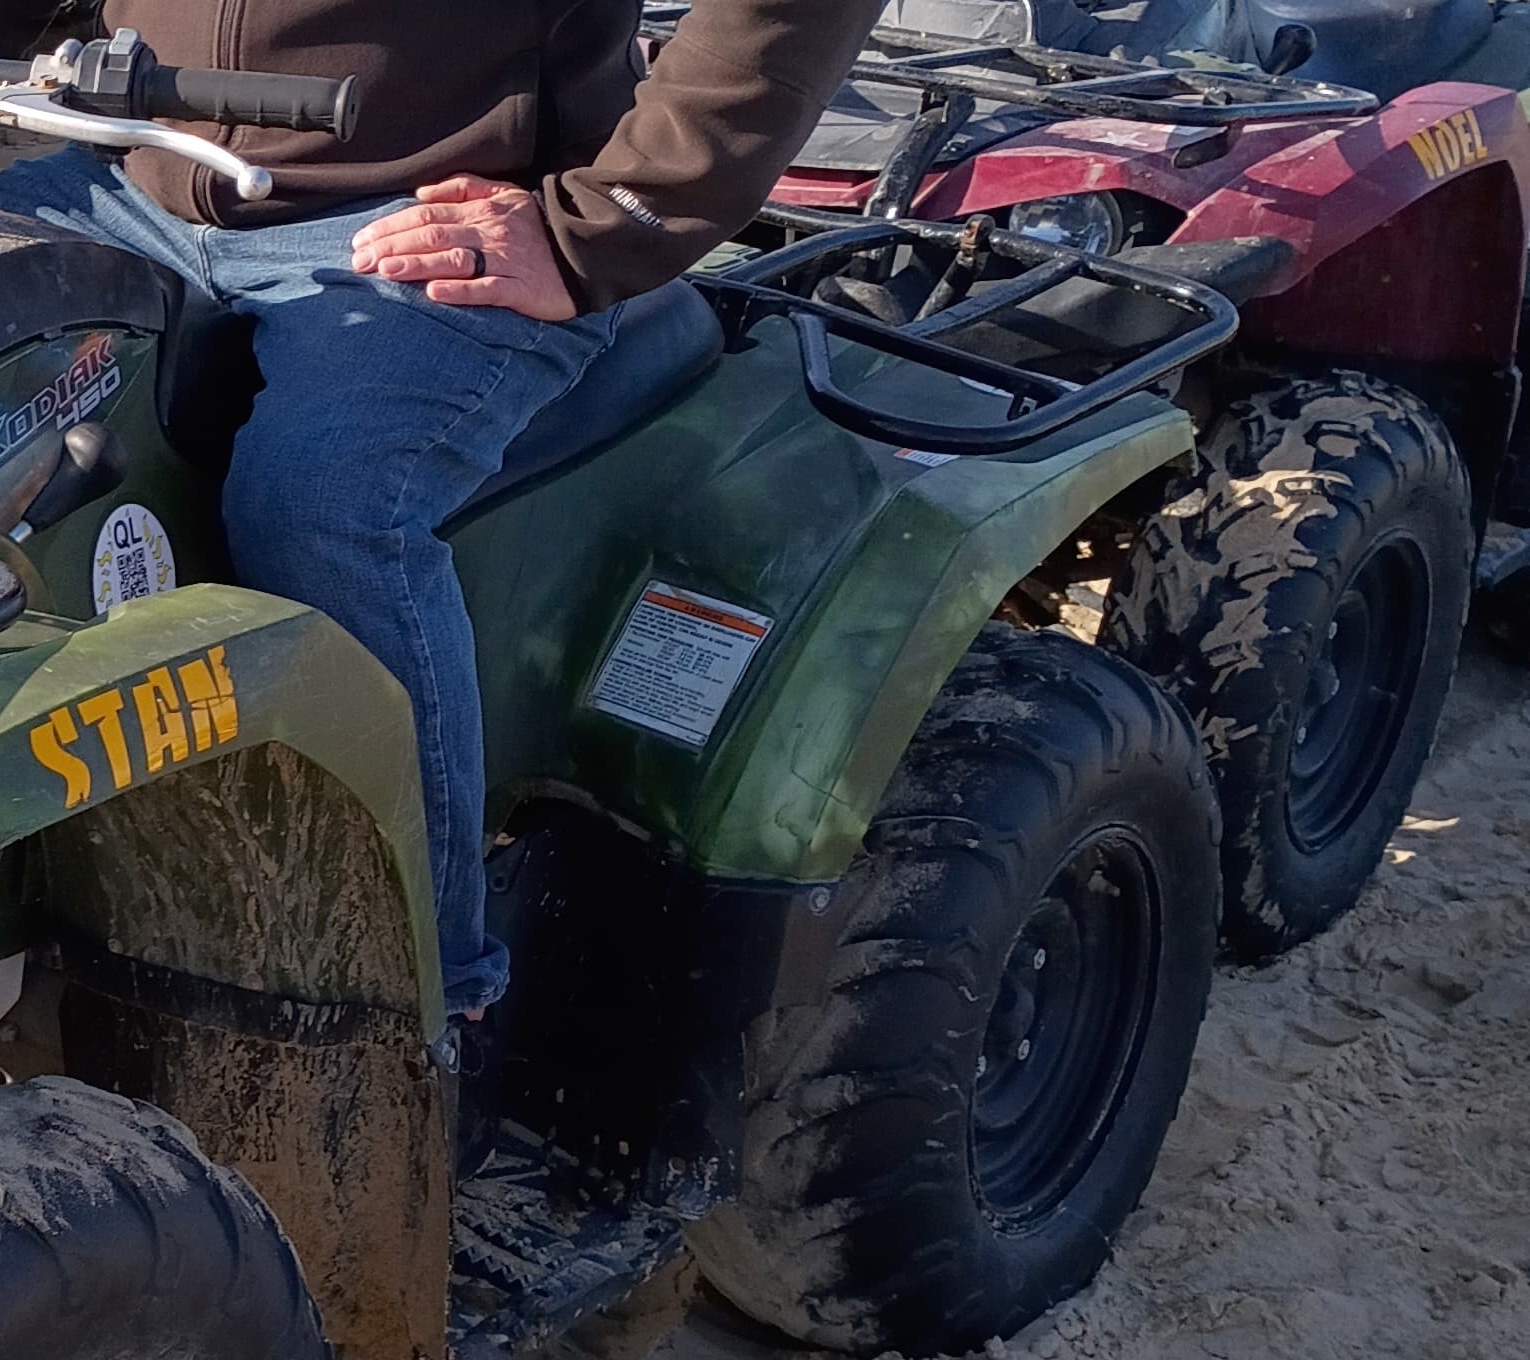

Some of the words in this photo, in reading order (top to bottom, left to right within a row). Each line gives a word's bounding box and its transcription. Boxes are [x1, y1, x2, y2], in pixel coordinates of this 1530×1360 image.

[1408, 108, 1488, 181] NOEL
[55, 364, 121, 431] 450
[113, 516, 143, 549] QL
[30, 644, 239, 810] STAN
